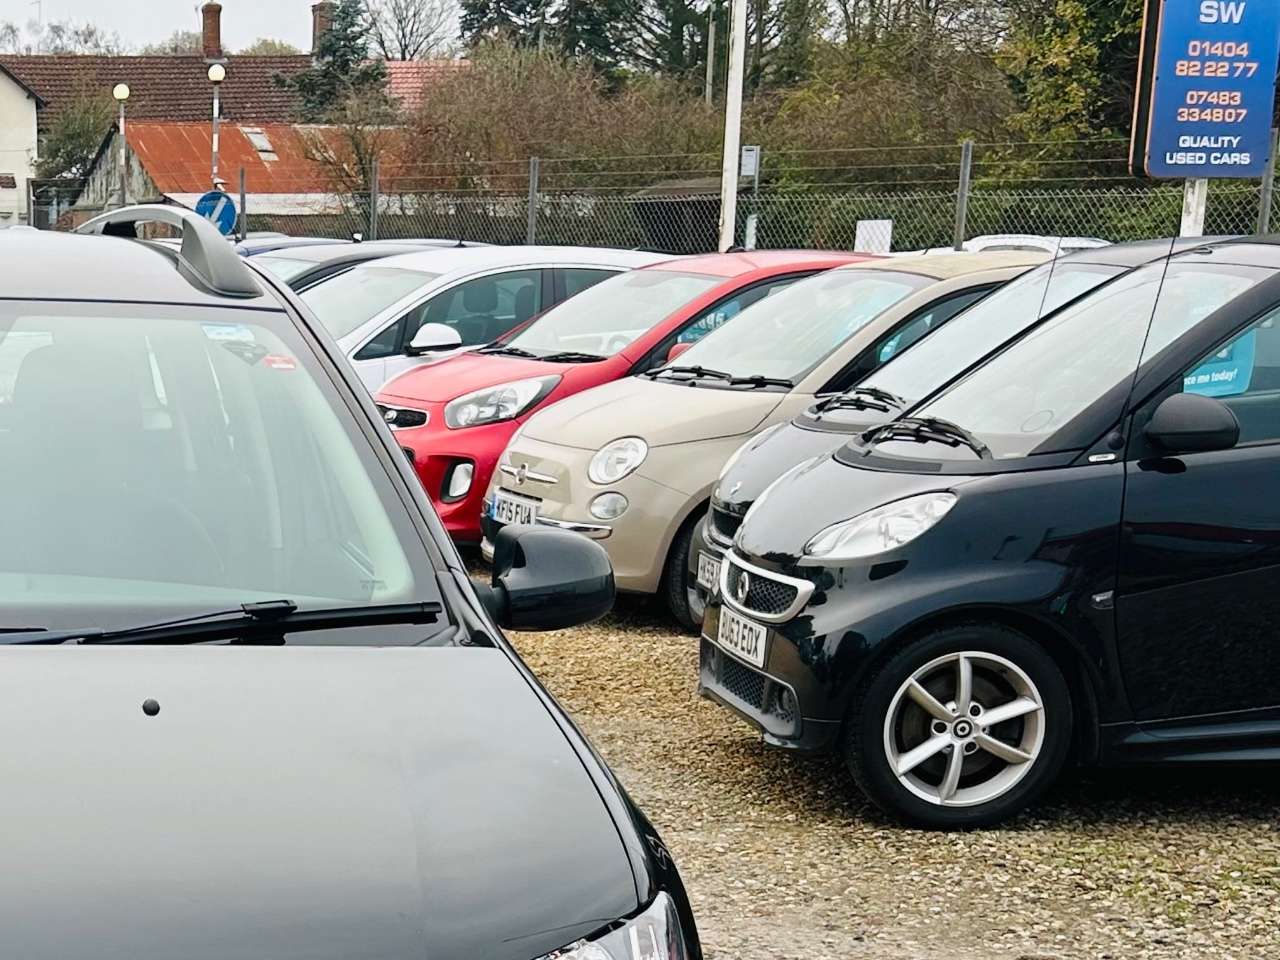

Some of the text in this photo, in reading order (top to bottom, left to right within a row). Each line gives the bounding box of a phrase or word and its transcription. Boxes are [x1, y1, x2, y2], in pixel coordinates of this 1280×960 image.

[1199, 0, 1246, 24] SW
[1188, 40, 1249, 57] 01404
[1186, 90, 1242, 105] 07483
[1176, 107, 1248, 123] 334807
[1178, 135, 1241, 149] QUALITY
[1165, 152, 1251, 165] USED CARS
